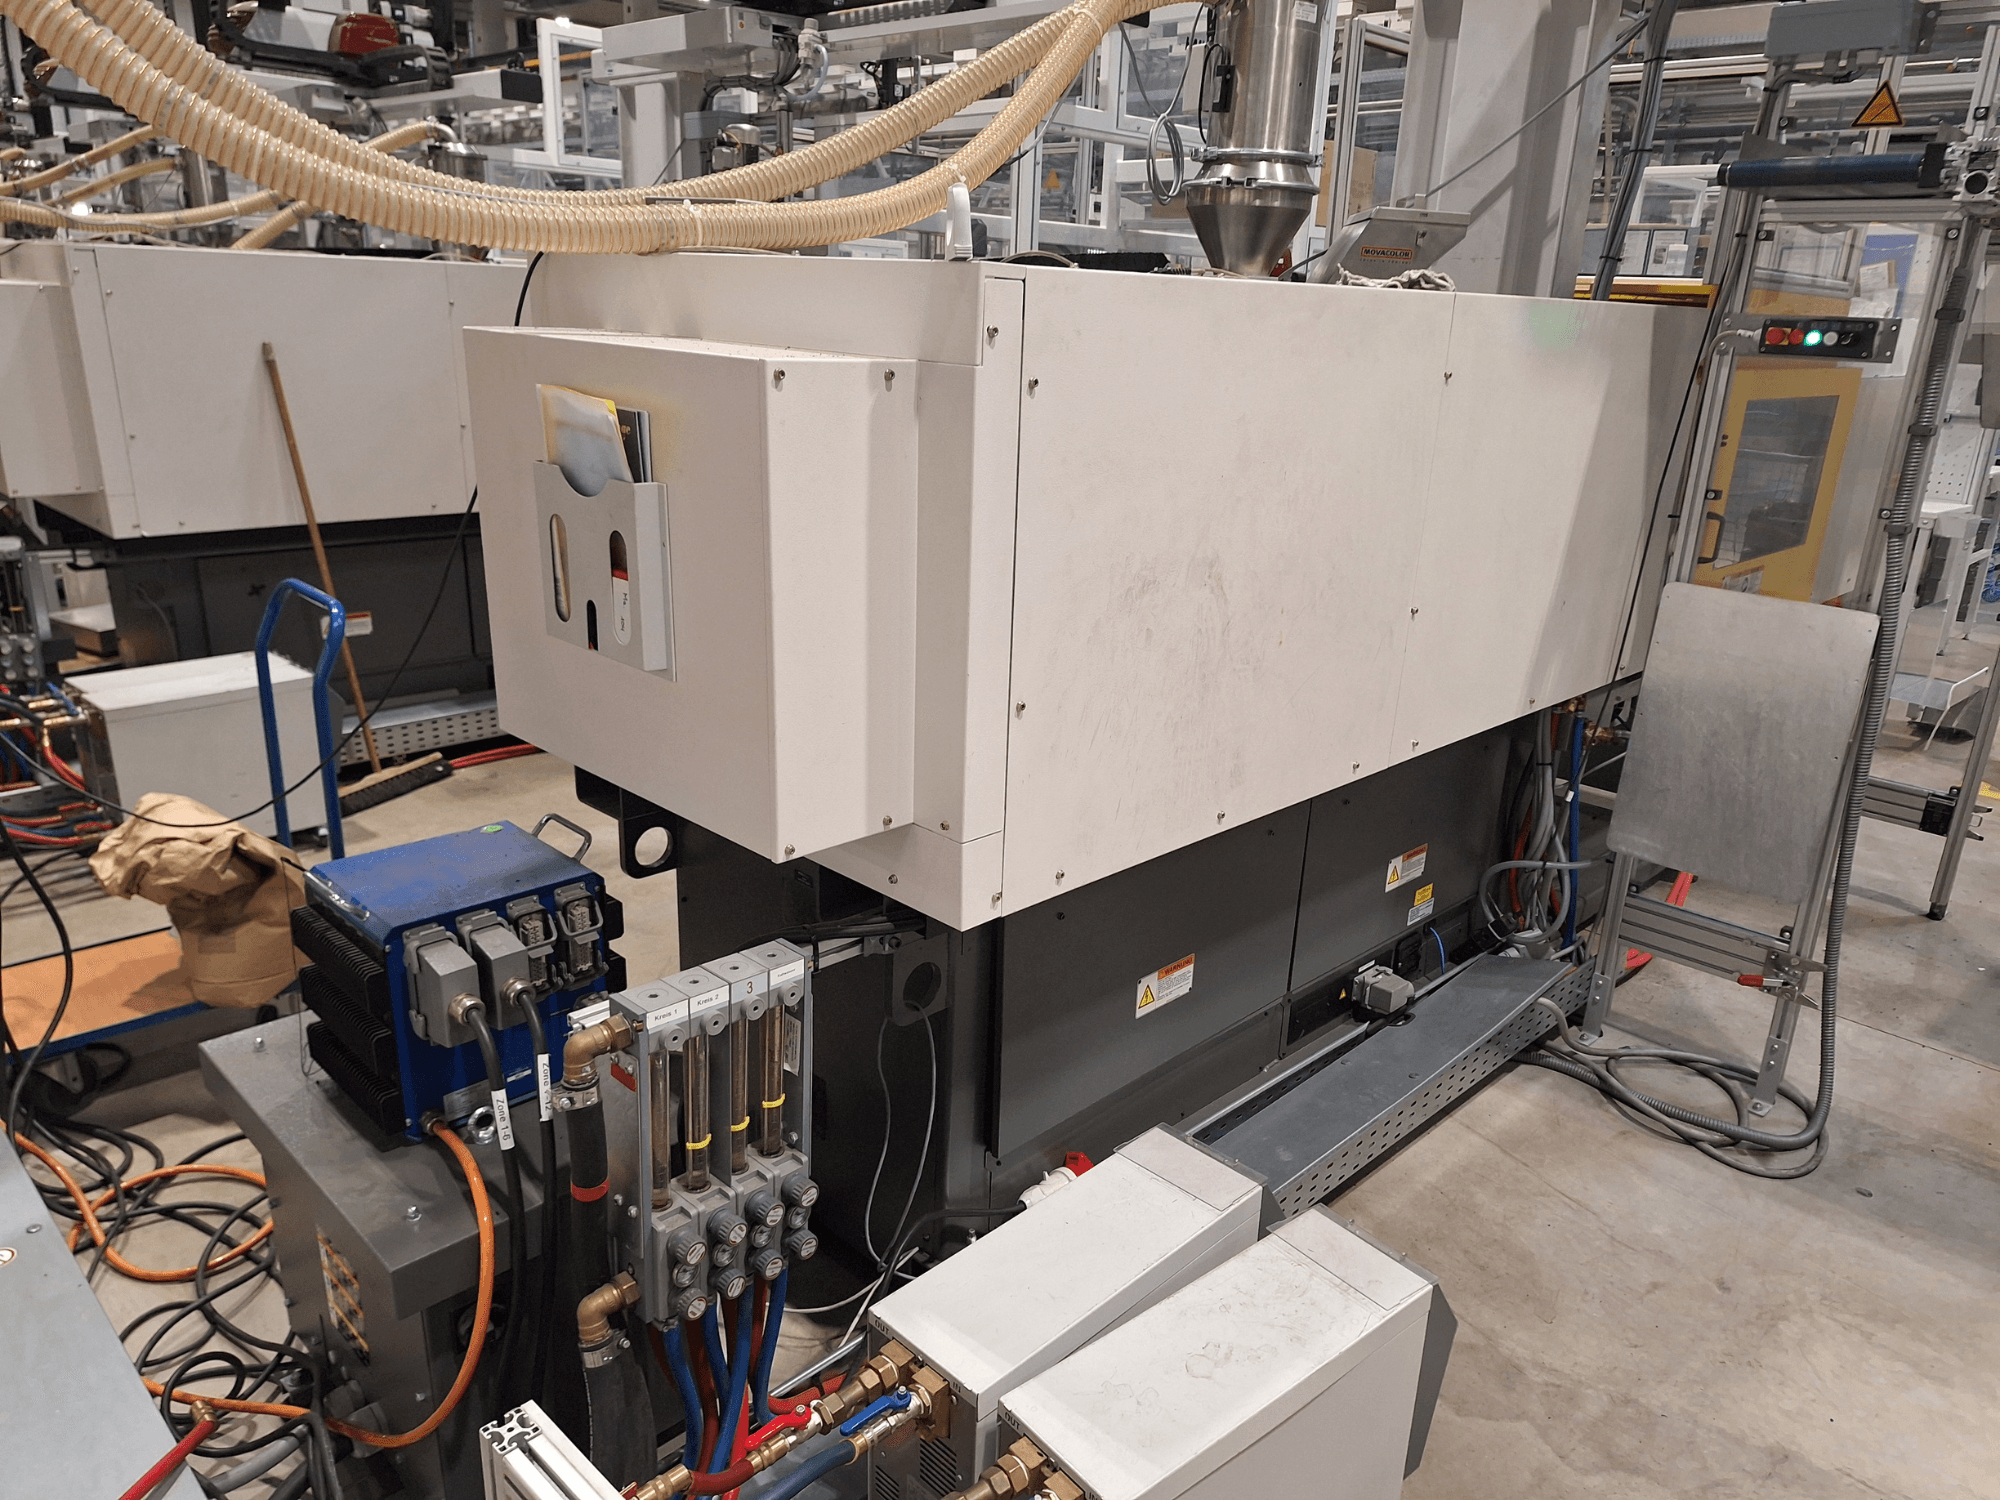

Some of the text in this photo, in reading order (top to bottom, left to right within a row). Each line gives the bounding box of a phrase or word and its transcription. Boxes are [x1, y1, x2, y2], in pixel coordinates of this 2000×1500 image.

[1363, 248, 1410, 258] MOVACOLOR
[746, 981, 754, 994] 3
[697, 997, 713, 1007] Kreis
[654, 1010, 672, 1021] Kreis
[542, 1063, 550, 1087] Zone
[496, 1098, 511, 1141] Zone 1-6
[874, 1319, 890, 1335] OUT
[952, 1381, 962, 1394] IN
[1004, 1412, 1021, 1430] OUT
